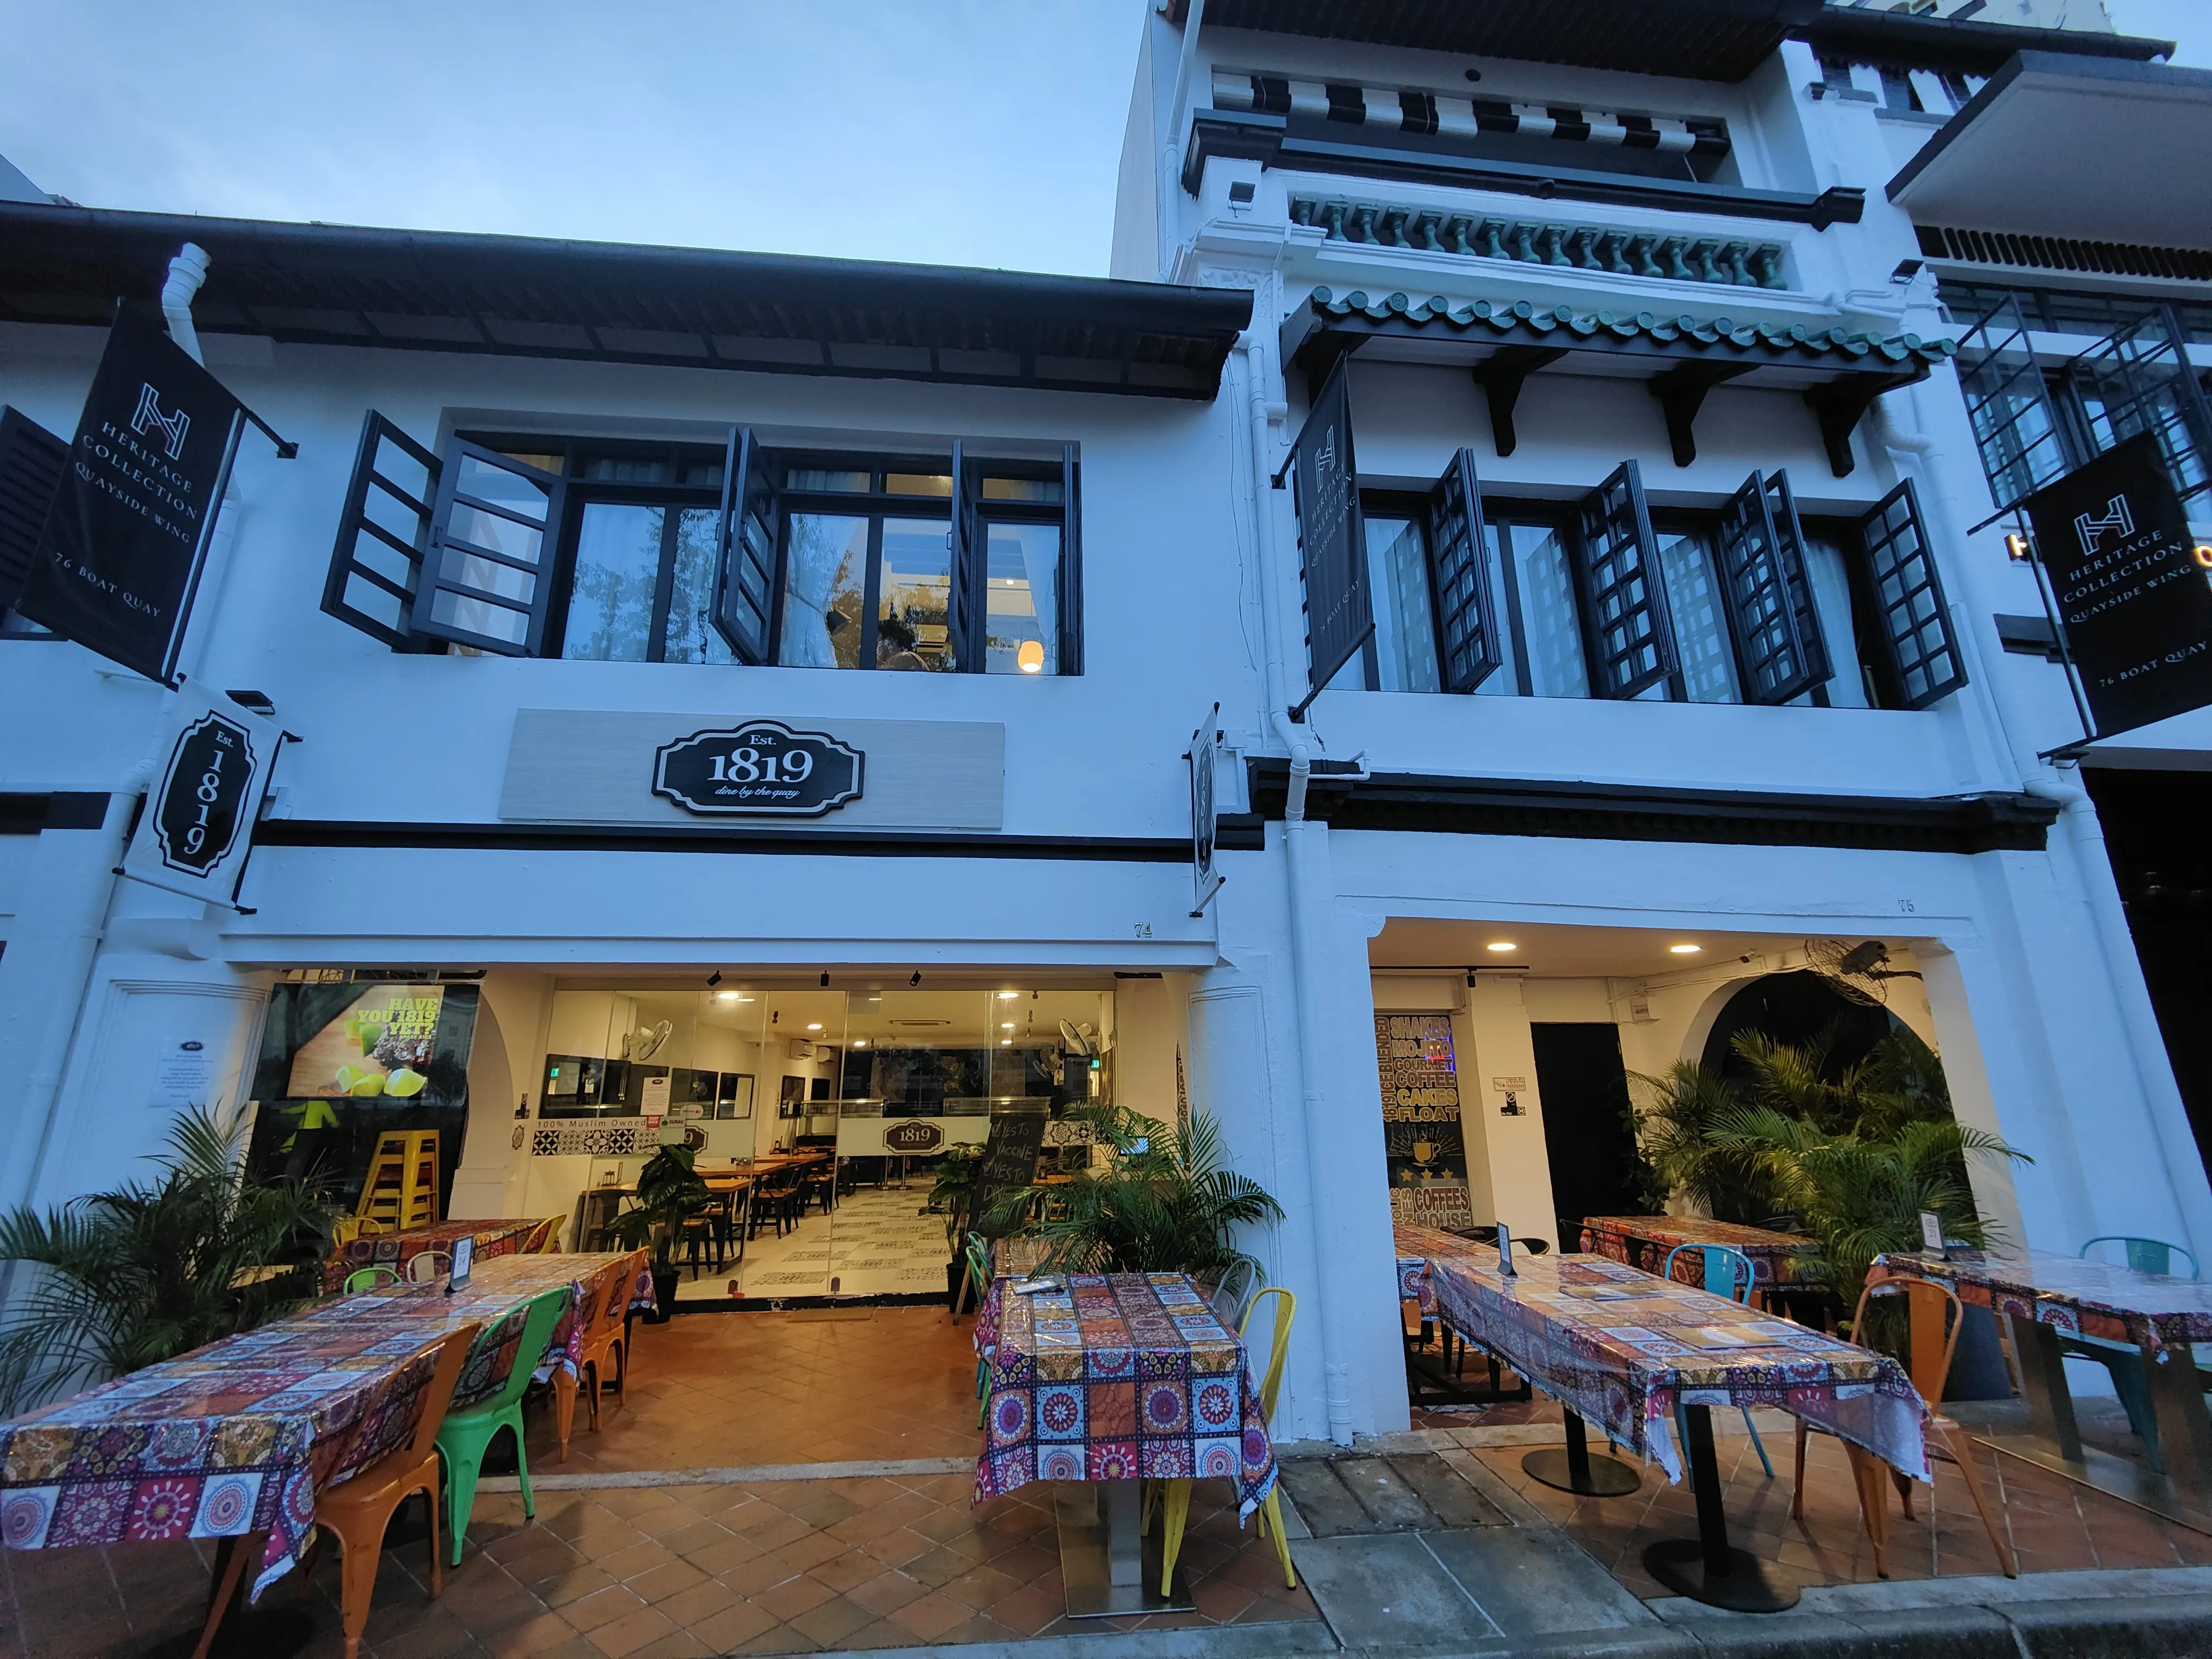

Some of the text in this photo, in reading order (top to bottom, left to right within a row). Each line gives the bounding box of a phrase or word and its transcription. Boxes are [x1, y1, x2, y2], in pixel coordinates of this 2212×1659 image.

[102, 422, 192, 493] HERITAGE
[83, 435, 198, 520] COLLECTION
[76, 462, 191, 543] QUAYSIDE WING
[1312, 461, 1345, 522] HERITAGE
[1310, 471, 1352, 547] COLLECTION
[1311, 496, 1355, 567] QUAYSIDE WING
[2070, 530, 2163, 582] HERITAGE
[2063, 542, 2183, 603] COLLECTION
[56, 552, 161, 617] 76 BOAT QUAY
[2070, 564, 2191, 623] QUAYSIDE WING
[1326, 601, 1341, 626] BOAT
[1342, 578, 1360, 603] QUAY
[2100, 640, 2208, 687] 76 BOAT QUAY
[215, 730, 233, 747] Est.
[749, 734, 777, 746] Est.
[707, 747, 813, 783] 1819
[184, 750, 224, 855] 1819
[715, 786, 800, 799] dine by the quay
[1134, 922, 1152, 938] 74
[388, 998, 439, 1010] HAVE
[358, 1010, 436, 1022] YOU 1819
[389, 1022, 434, 1035] YET?
[1390, 1016, 1451, 1039] SHAKES
[1392, 1040, 1452, 1058] MOJITO
[1374, 1016, 1398, 1122] 1819 ICE BLENDED
[1394, 1058, 1454, 1071] GOURMET
[1395, 1071, 1456, 1087] COFFEE
[1397, 1088, 1458, 1106] CAKES
[611, 1118, 646, 1127] Owned
[1398, 1107, 1459, 1122] FLOAT
[899, 1128, 930, 1142] 1819
[996, 1139, 1033, 1161] VACCINE
[992, 1161, 1013, 1181] YES
[1413, 1186, 1469, 1212] COFFEES
[1415, 1211, 1472, 1227] HOUSE
